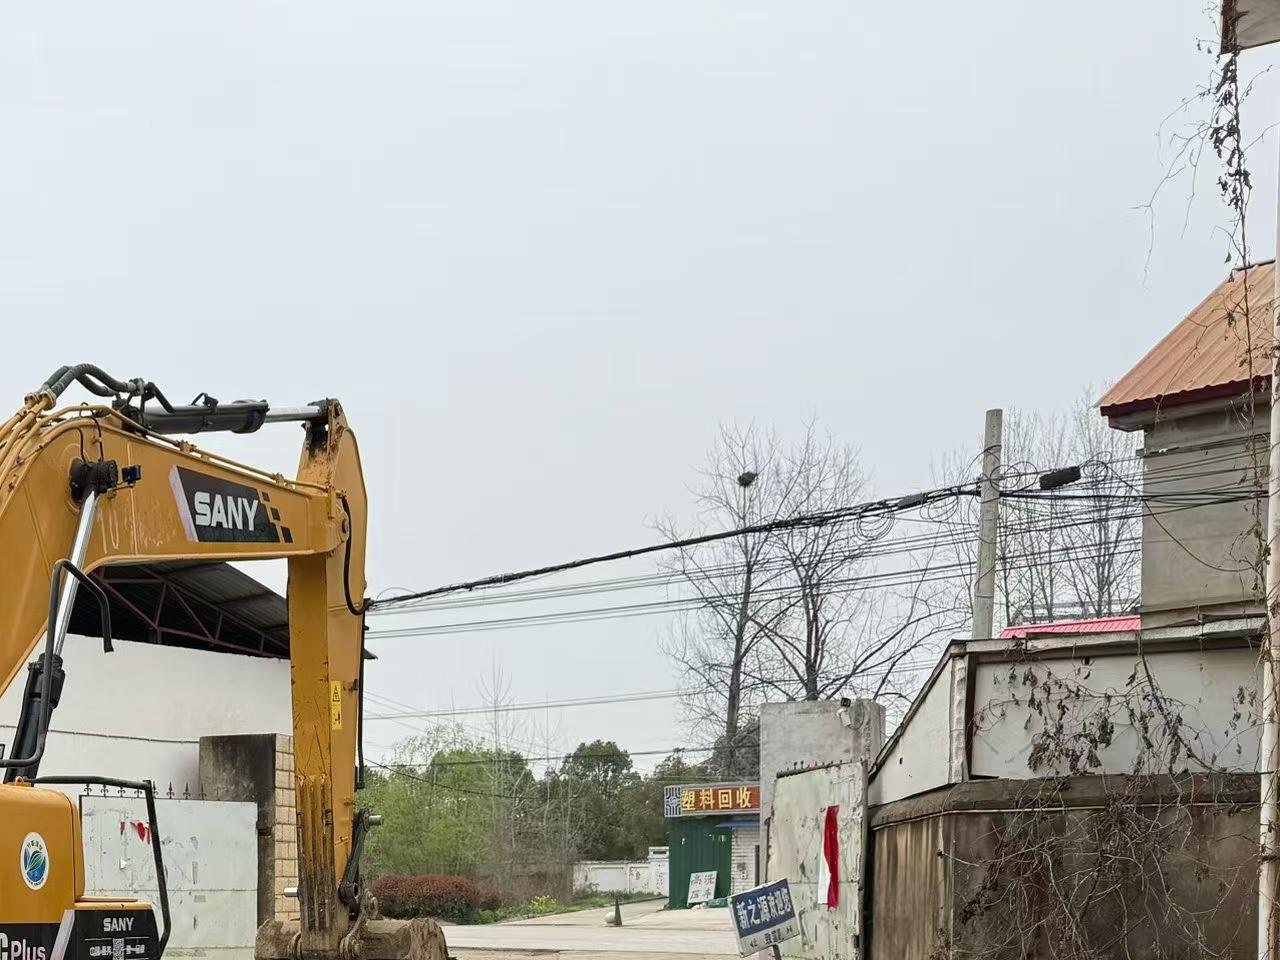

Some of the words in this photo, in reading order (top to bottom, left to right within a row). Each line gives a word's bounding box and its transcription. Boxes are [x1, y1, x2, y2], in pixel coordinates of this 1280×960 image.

[194, 491, 258, 531] SANY
[681, 787, 752, 811] 塑料回收
[103, 917, 134, 931] SANY
[736, 887, 791, 930] 新之源欢迎您
